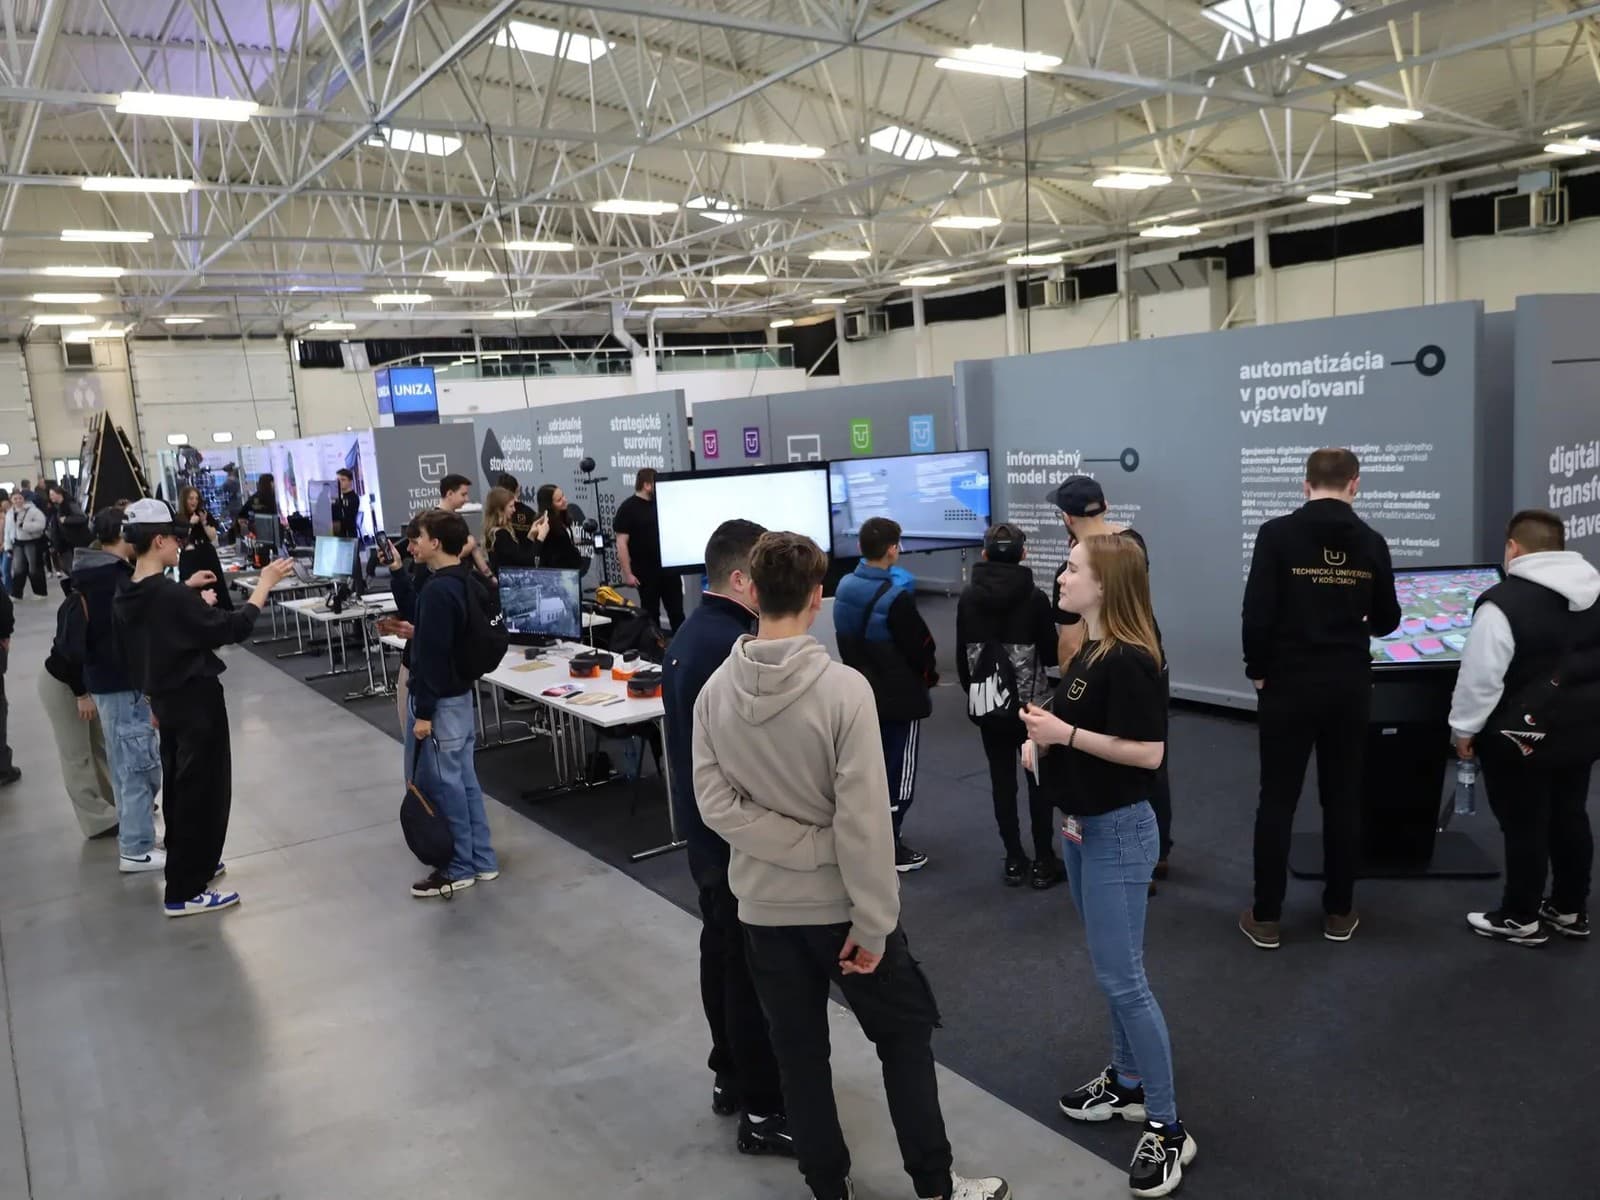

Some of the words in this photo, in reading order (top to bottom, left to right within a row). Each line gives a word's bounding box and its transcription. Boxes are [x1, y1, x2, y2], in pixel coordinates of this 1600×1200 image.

[1240, 350, 1385, 380] automatizácia
[394, 383, 432, 396] UNIZA
[1240, 387, 1252, 402] v
[1255, 374, 1366, 405] povoľovaní
[610, 412, 661, 434] strategické
[1240, 403, 1328, 428] výstavby
[501, 435, 532, 455] digitálne
[624, 432, 662, 453] suroviny
[563, 445, 584, 460] stavby
[611, 455, 617, 467] a
[617, 451, 664, 468] inovatívne
[1006, 449, 1081, 469] informačný
[1007, 469, 1046, 484] model
[408, 487, 442, 498] TECHN
[1292, 567, 1334, 576] TECHNICKÁ
[1312, 576, 1318, 584] V
